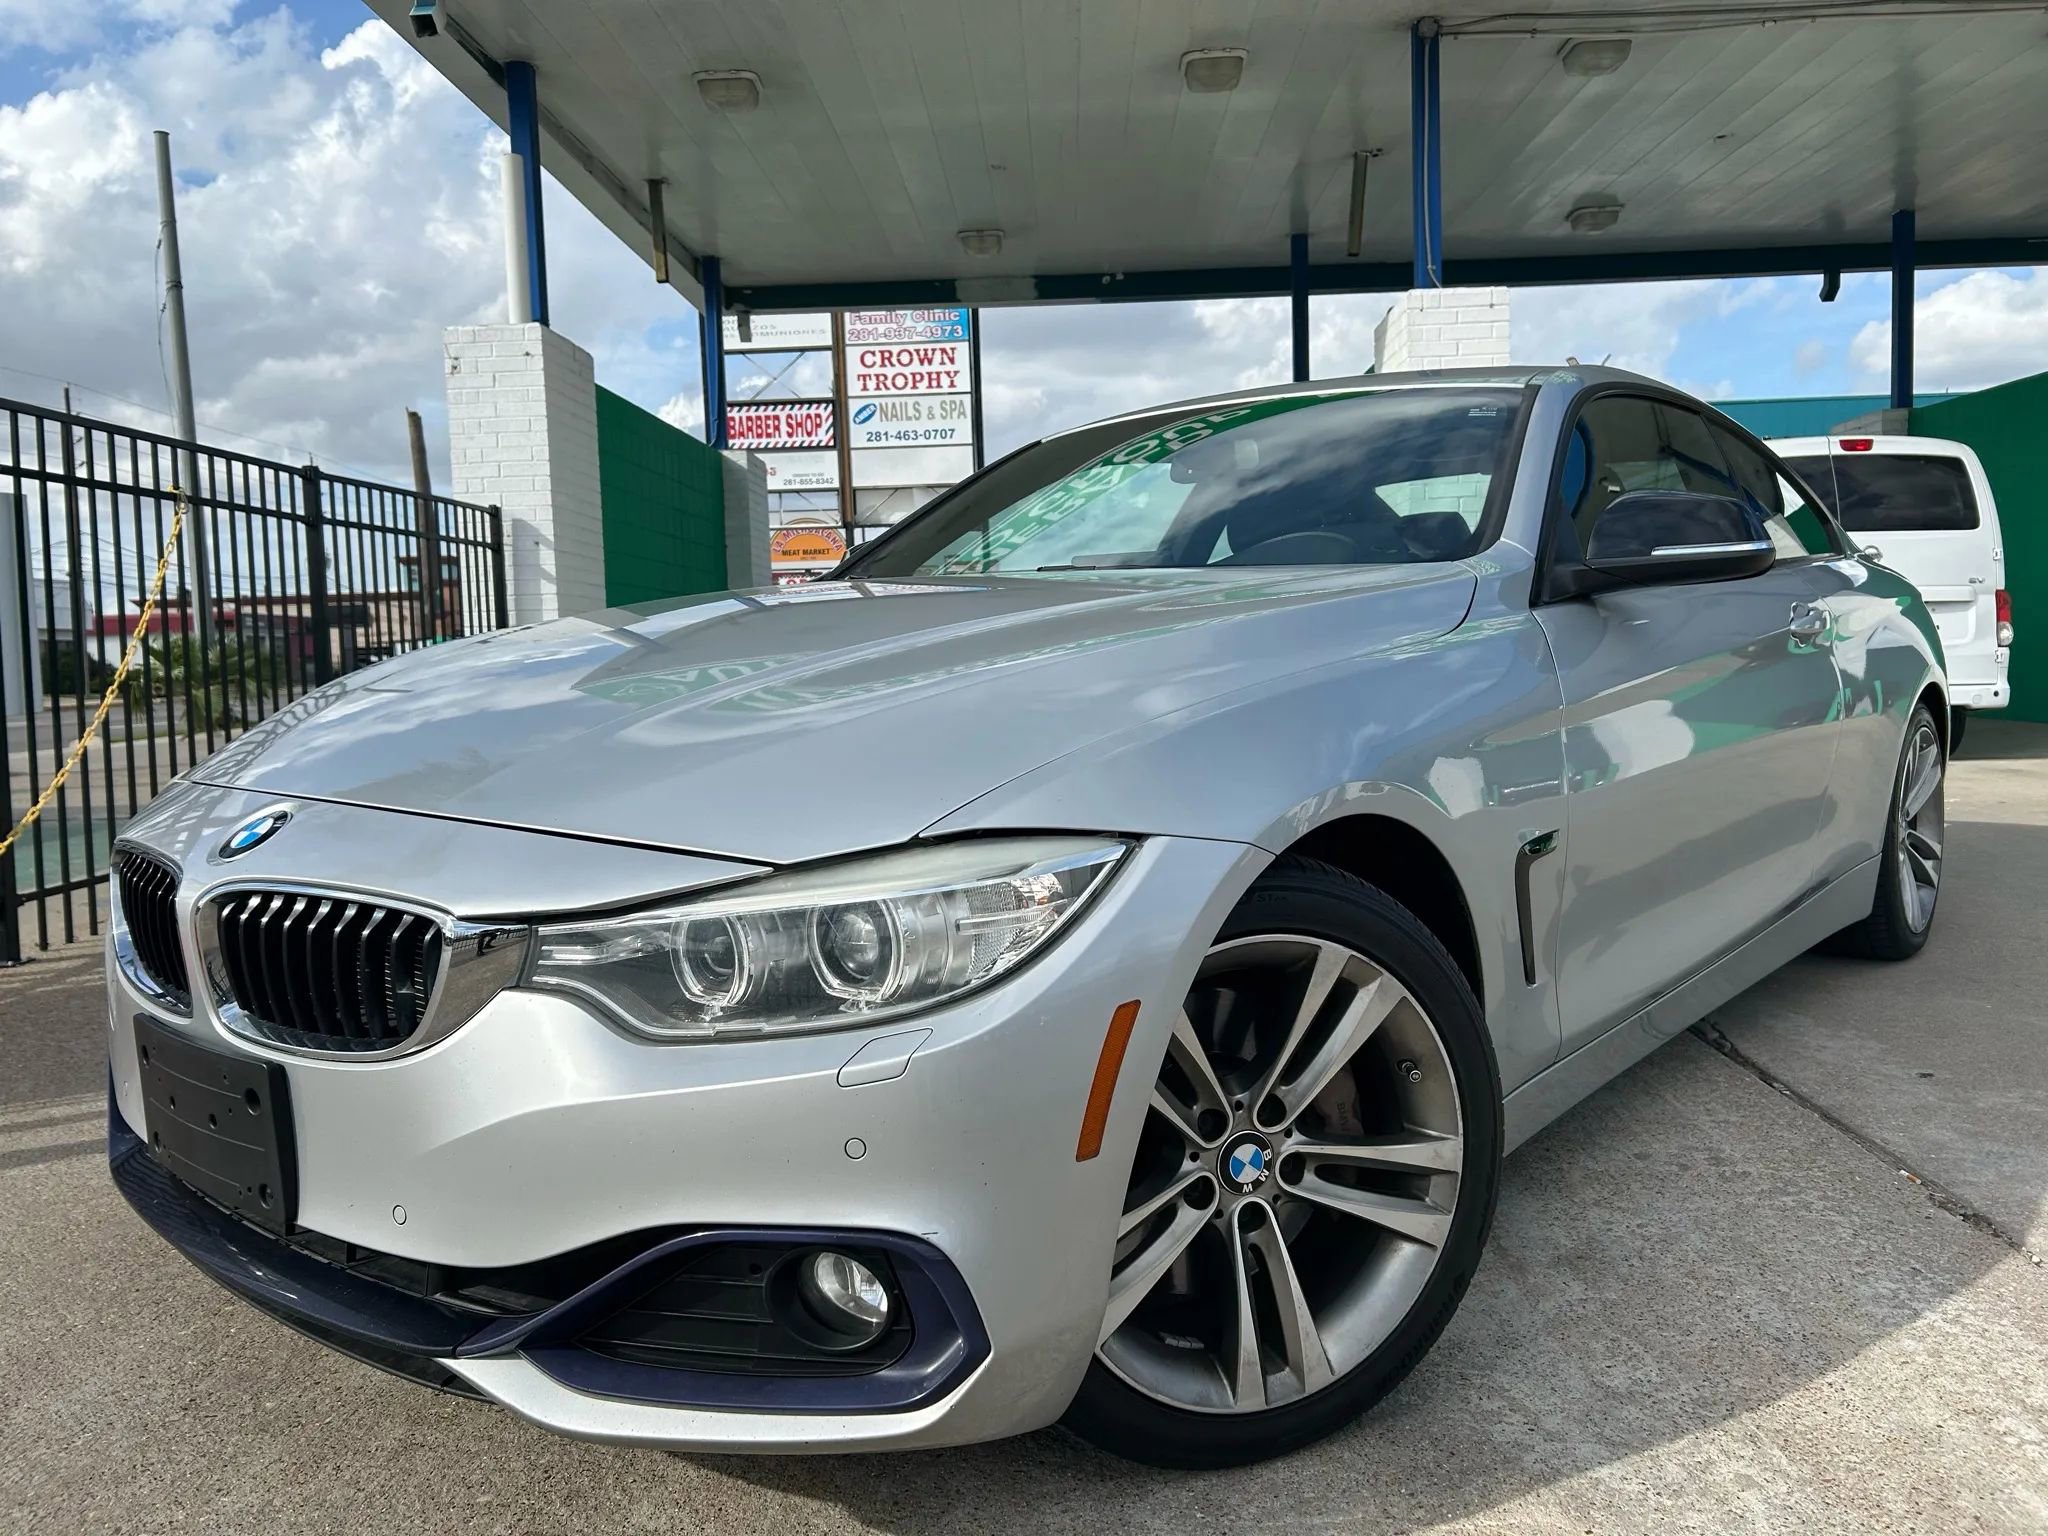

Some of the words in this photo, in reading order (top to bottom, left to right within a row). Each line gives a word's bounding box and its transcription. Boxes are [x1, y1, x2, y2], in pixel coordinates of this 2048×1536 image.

[849, 309, 907, 326] Family
[911, 309, 961, 322] Clinic
[848, 325, 962, 342] 281-937-4973
[860, 347, 957, 369] CROWN
[857, 370, 960, 392] TROPHY
[879, 401, 921, 423] NAILS
[927, 406, 936, 420] &
[940, 399, 968, 420] SPA
[726, 415, 781, 440] BARBER
[786, 413, 822, 438] SHOP
[866, 428, 955, 443] 281-463-0707
